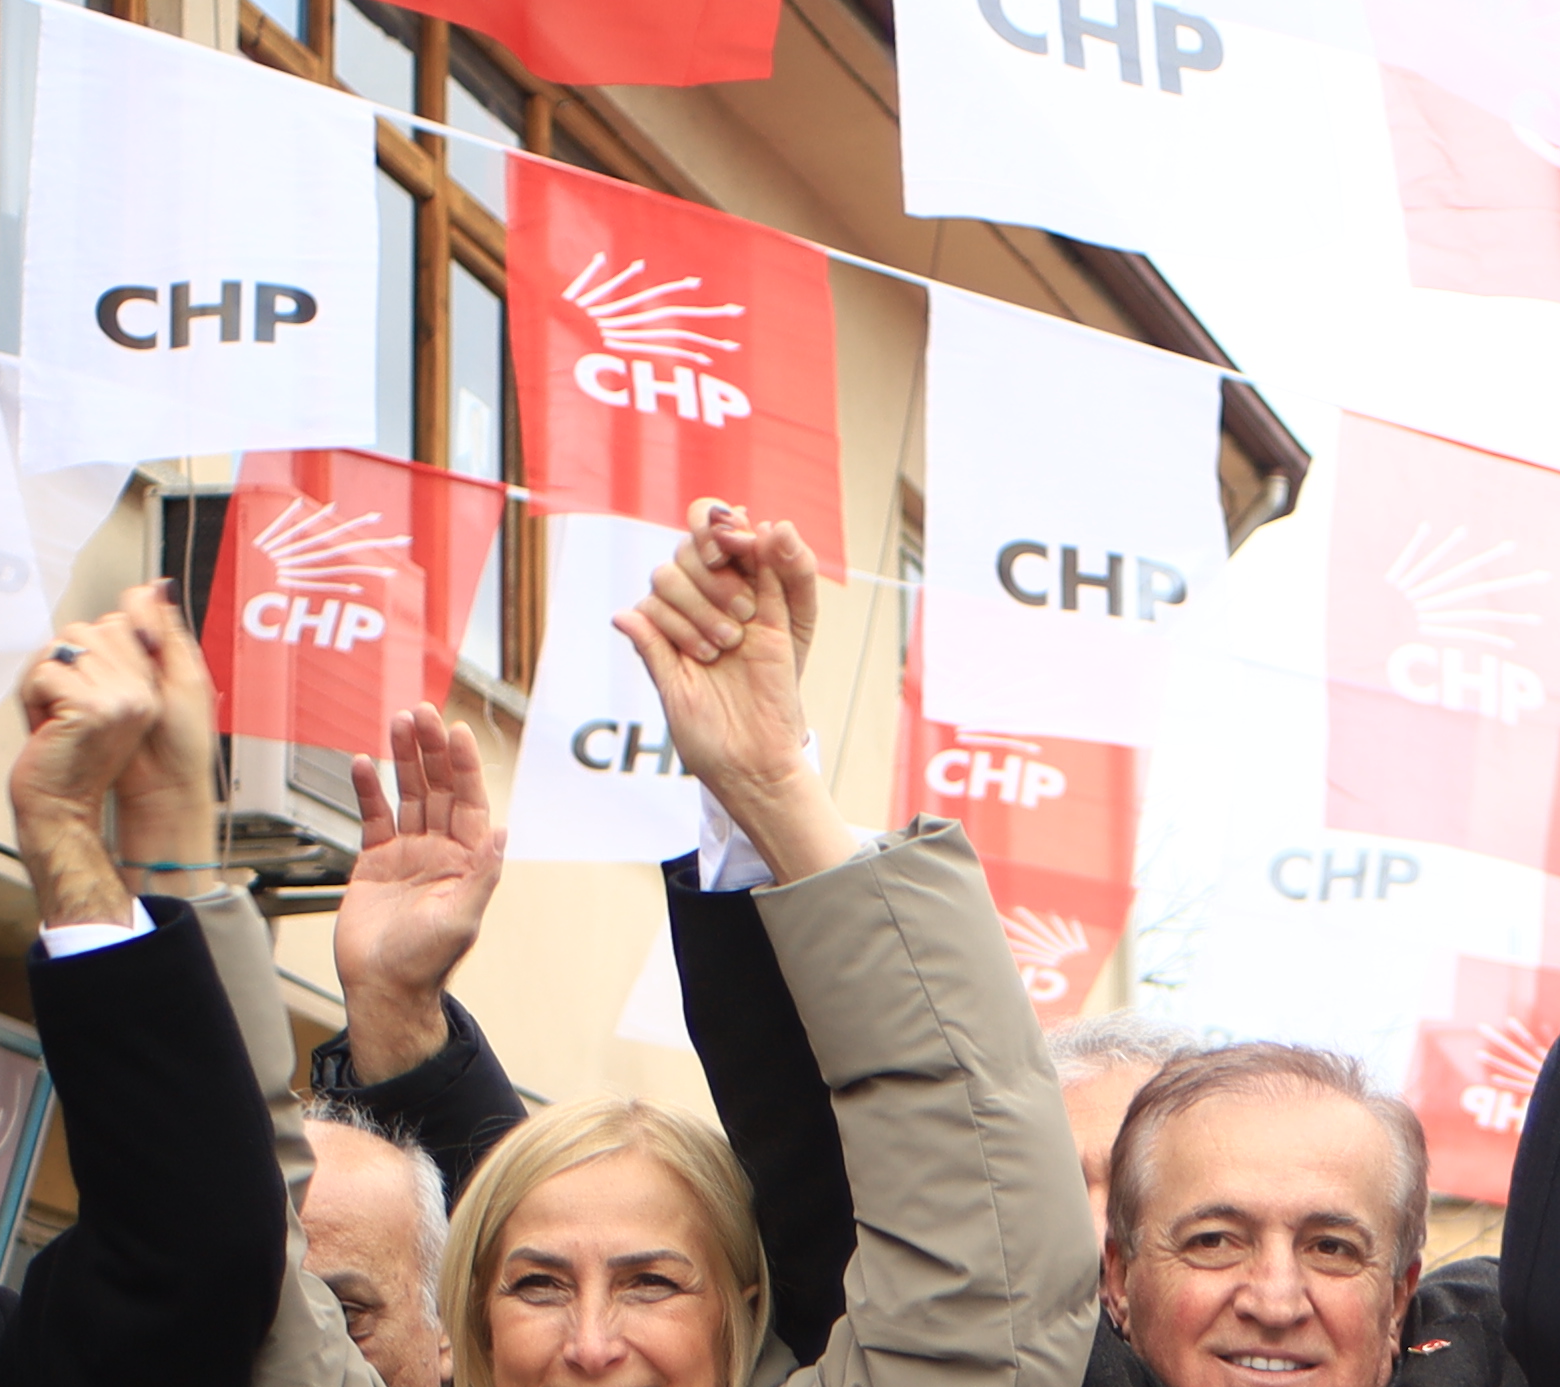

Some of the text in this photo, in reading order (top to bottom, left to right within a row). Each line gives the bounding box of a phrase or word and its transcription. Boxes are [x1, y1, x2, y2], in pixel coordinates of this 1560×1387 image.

[94, 280, 319, 351] CHP
[573, 352, 752, 428] CHP
[996, 538, 1188, 618] CHP
[242, 591, 385, 653] CHP
[1386, 642, 1544, 726] CHP
[572, 721, 685, 774] CH
[924, 748, 1066, 808] CHP
[1268, 846, 1420, 902] CHP
